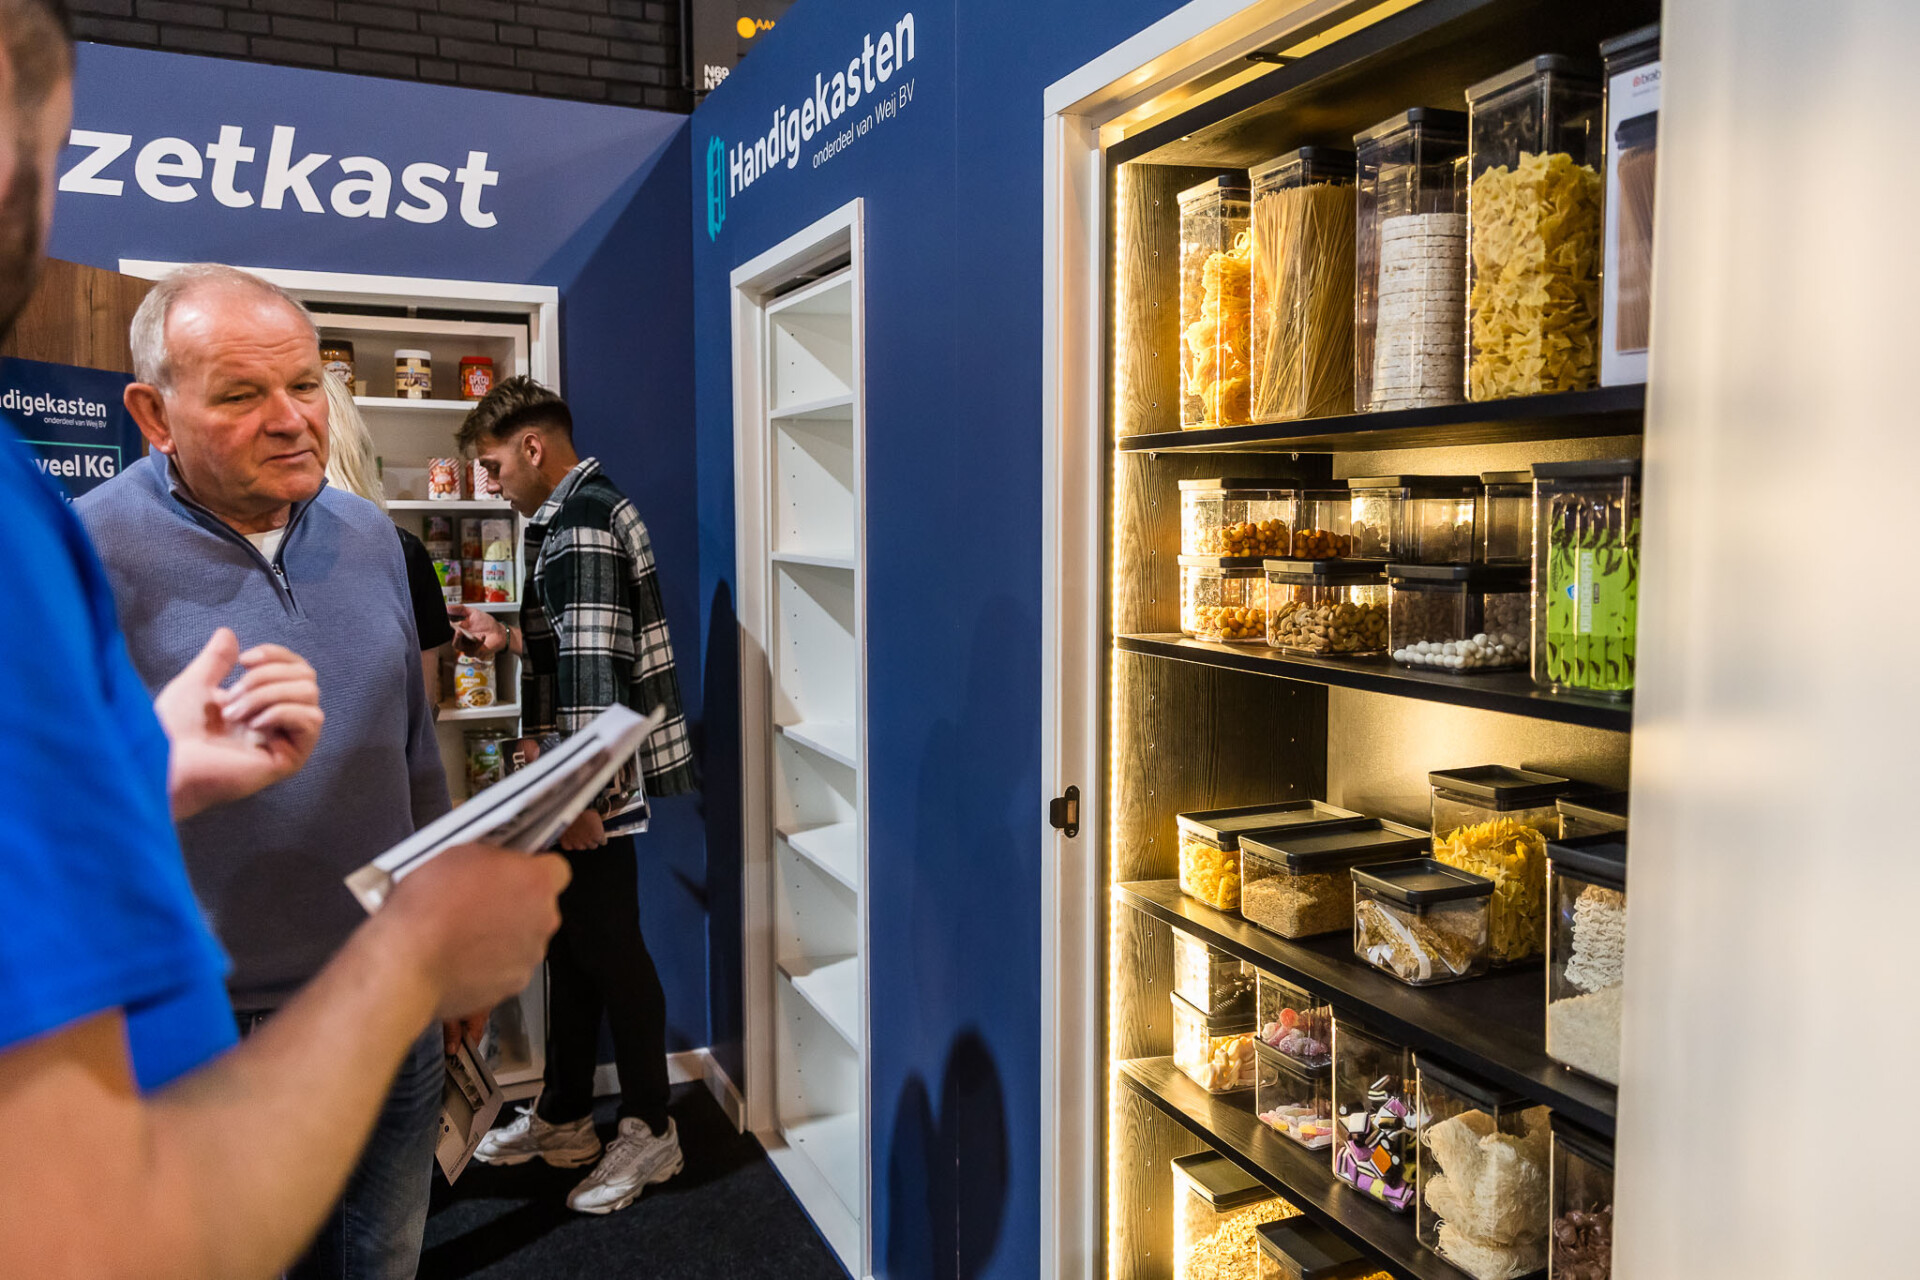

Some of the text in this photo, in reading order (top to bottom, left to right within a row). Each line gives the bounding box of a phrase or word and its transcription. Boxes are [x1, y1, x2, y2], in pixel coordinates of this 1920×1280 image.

[729, 12, 915, 198] Handigekasten
[813, 78, 915, 169] onderdeel van Weij BV
[58, 125, 498, 228] zetkast
[0, 388, 107, 418] digekasten
[33, 454, 115, 478] veel KG
